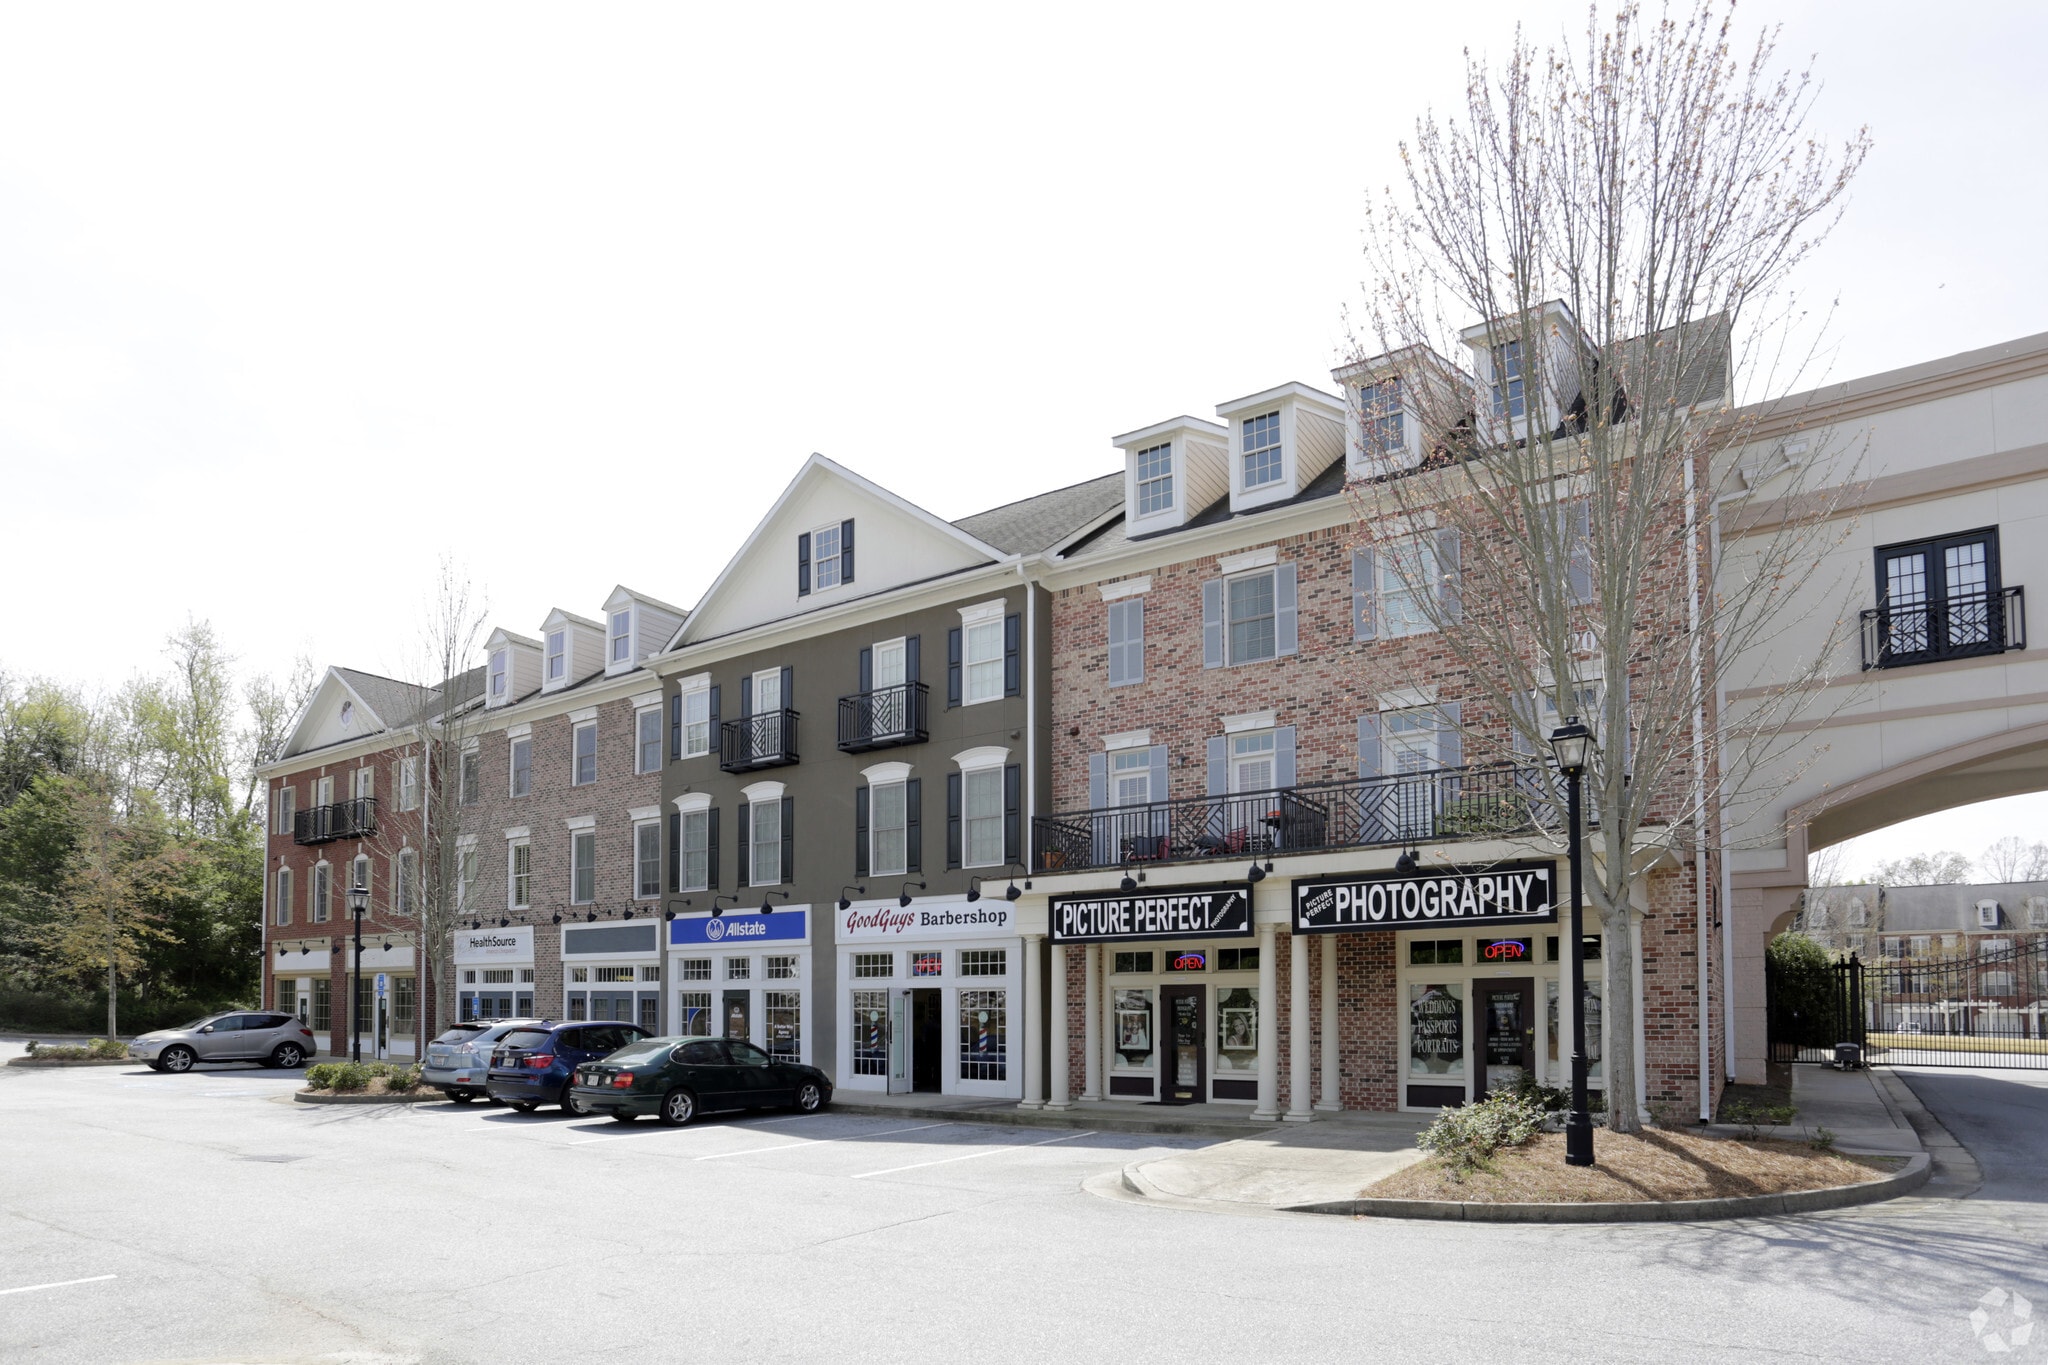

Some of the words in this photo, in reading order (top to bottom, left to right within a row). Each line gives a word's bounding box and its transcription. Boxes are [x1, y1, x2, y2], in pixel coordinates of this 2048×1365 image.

[1305, 888, 1333, 910] PICTURE
[1335, 874, 1534, 922] PHOTOGRAPHY
[1063, 901, 1130, 935] PICTURE
[1135, 896, 1213, 932] PERFECT
[1210, 893, 1238, 929] PHOTOGRAPHY
[1305, 897, 1334, 919] PERFECT
[725, 921, 766, 937] Allstate
[847, 908, 915, 934] GoodGuys
[920, 908, 1007, 926] Barbershop
[469, 936, 516, 948] HealthSource
[1485, 945, 1521, 958] OPEN
[1174, 957, 1202, 969] OPEN
[1418, 1000, 1456, 1014] WEDDINGS
[1418, 1019, 1457, 1034] PASSPORTS
[1417, 1039, 1458, 1053] PORTRAITS
